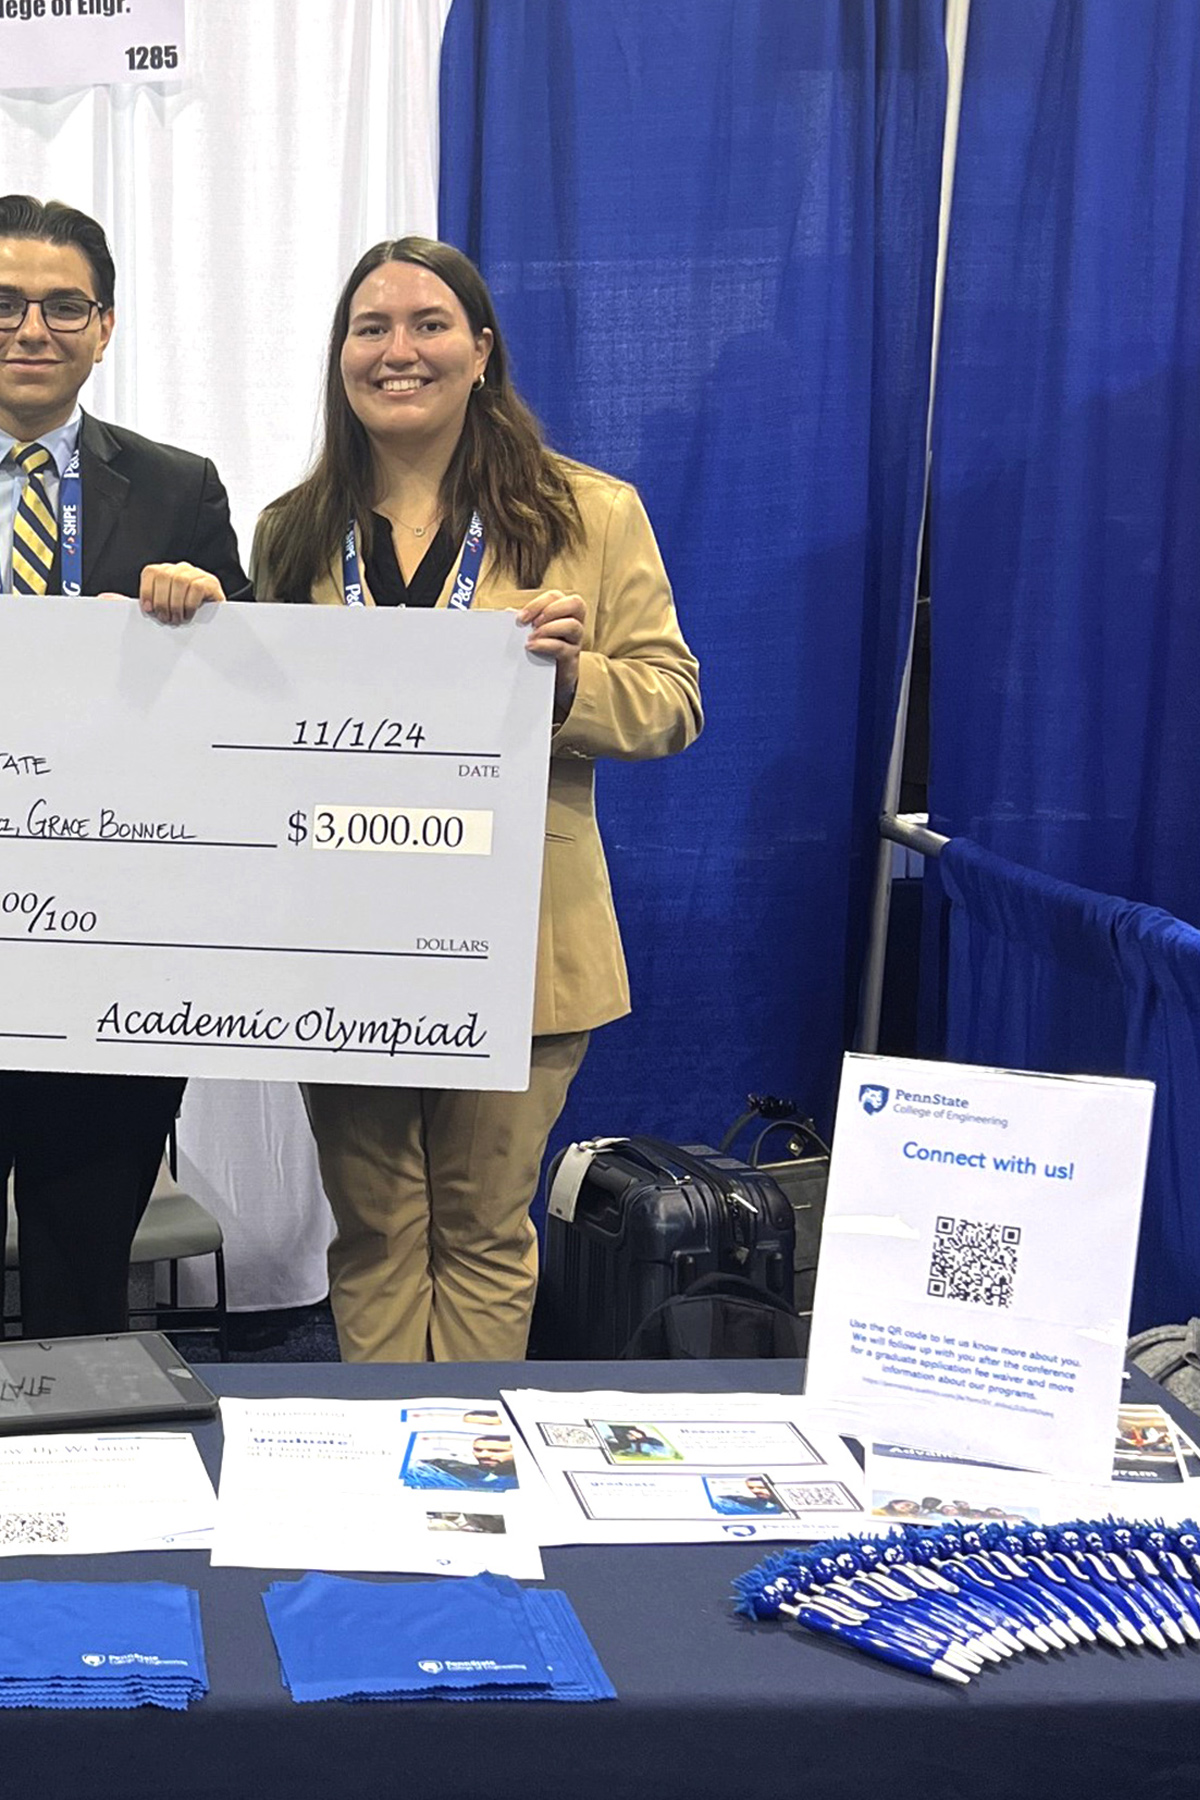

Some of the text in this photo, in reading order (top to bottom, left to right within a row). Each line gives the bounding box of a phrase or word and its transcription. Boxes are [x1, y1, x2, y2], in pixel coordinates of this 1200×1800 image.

[125, 45, 178, 70] 1285
[63, 504, 77, 536] SHPE
[450, 574, 474, 611] P&G
[292, 717, 425, 749] 11/1/24
[458, 764, 500, 778] DATE
[26, 799, 90, 838] GRACE
[99, 808, 196, 839] BONNELL
[1, 892, 97, 934] 00/100
[415, 937, 490, 952] DOLLARS
[97, 1001, 488, 1057] Academic Olympiad
[895, 1089, 969, 1108] PennState
[893, 1103, 1008, 1129] College of Engineering
[903, 1141, 1074, 1180] Connect with us!
[849, 1318, 867, 1329] Use
[869, 1323, 885, 1332] the
[887, 1325, 902, 1335] QR
[904, 1330, 927, 1340] code
[930, 1333, 940, 1342] to
[958, 1340, 969, 1348] us
[972, 1340, 998, 1352] know
[1001, 1347, 1026, 1357] more
[1029, 1351, 1058, 1363] about
[852, 1331, 1076, 1379] We will follow up with you after the conference
[851, 1344, 864, 1354] for
[875, 1351, 916, 1364] graduate
[920, 1359, 971, 1375] application
[975, 1367, 989, 1378] fee
[992, 1373, 1024, 1383] waiver
[1027, 1379, 1045, 1388] and
[1048, 1382, 1074, 1393] more
[882, 1364, 935, 1380] information
[938, 1375, 966, 1387] about
[969, 1381, 985, 1390] our
